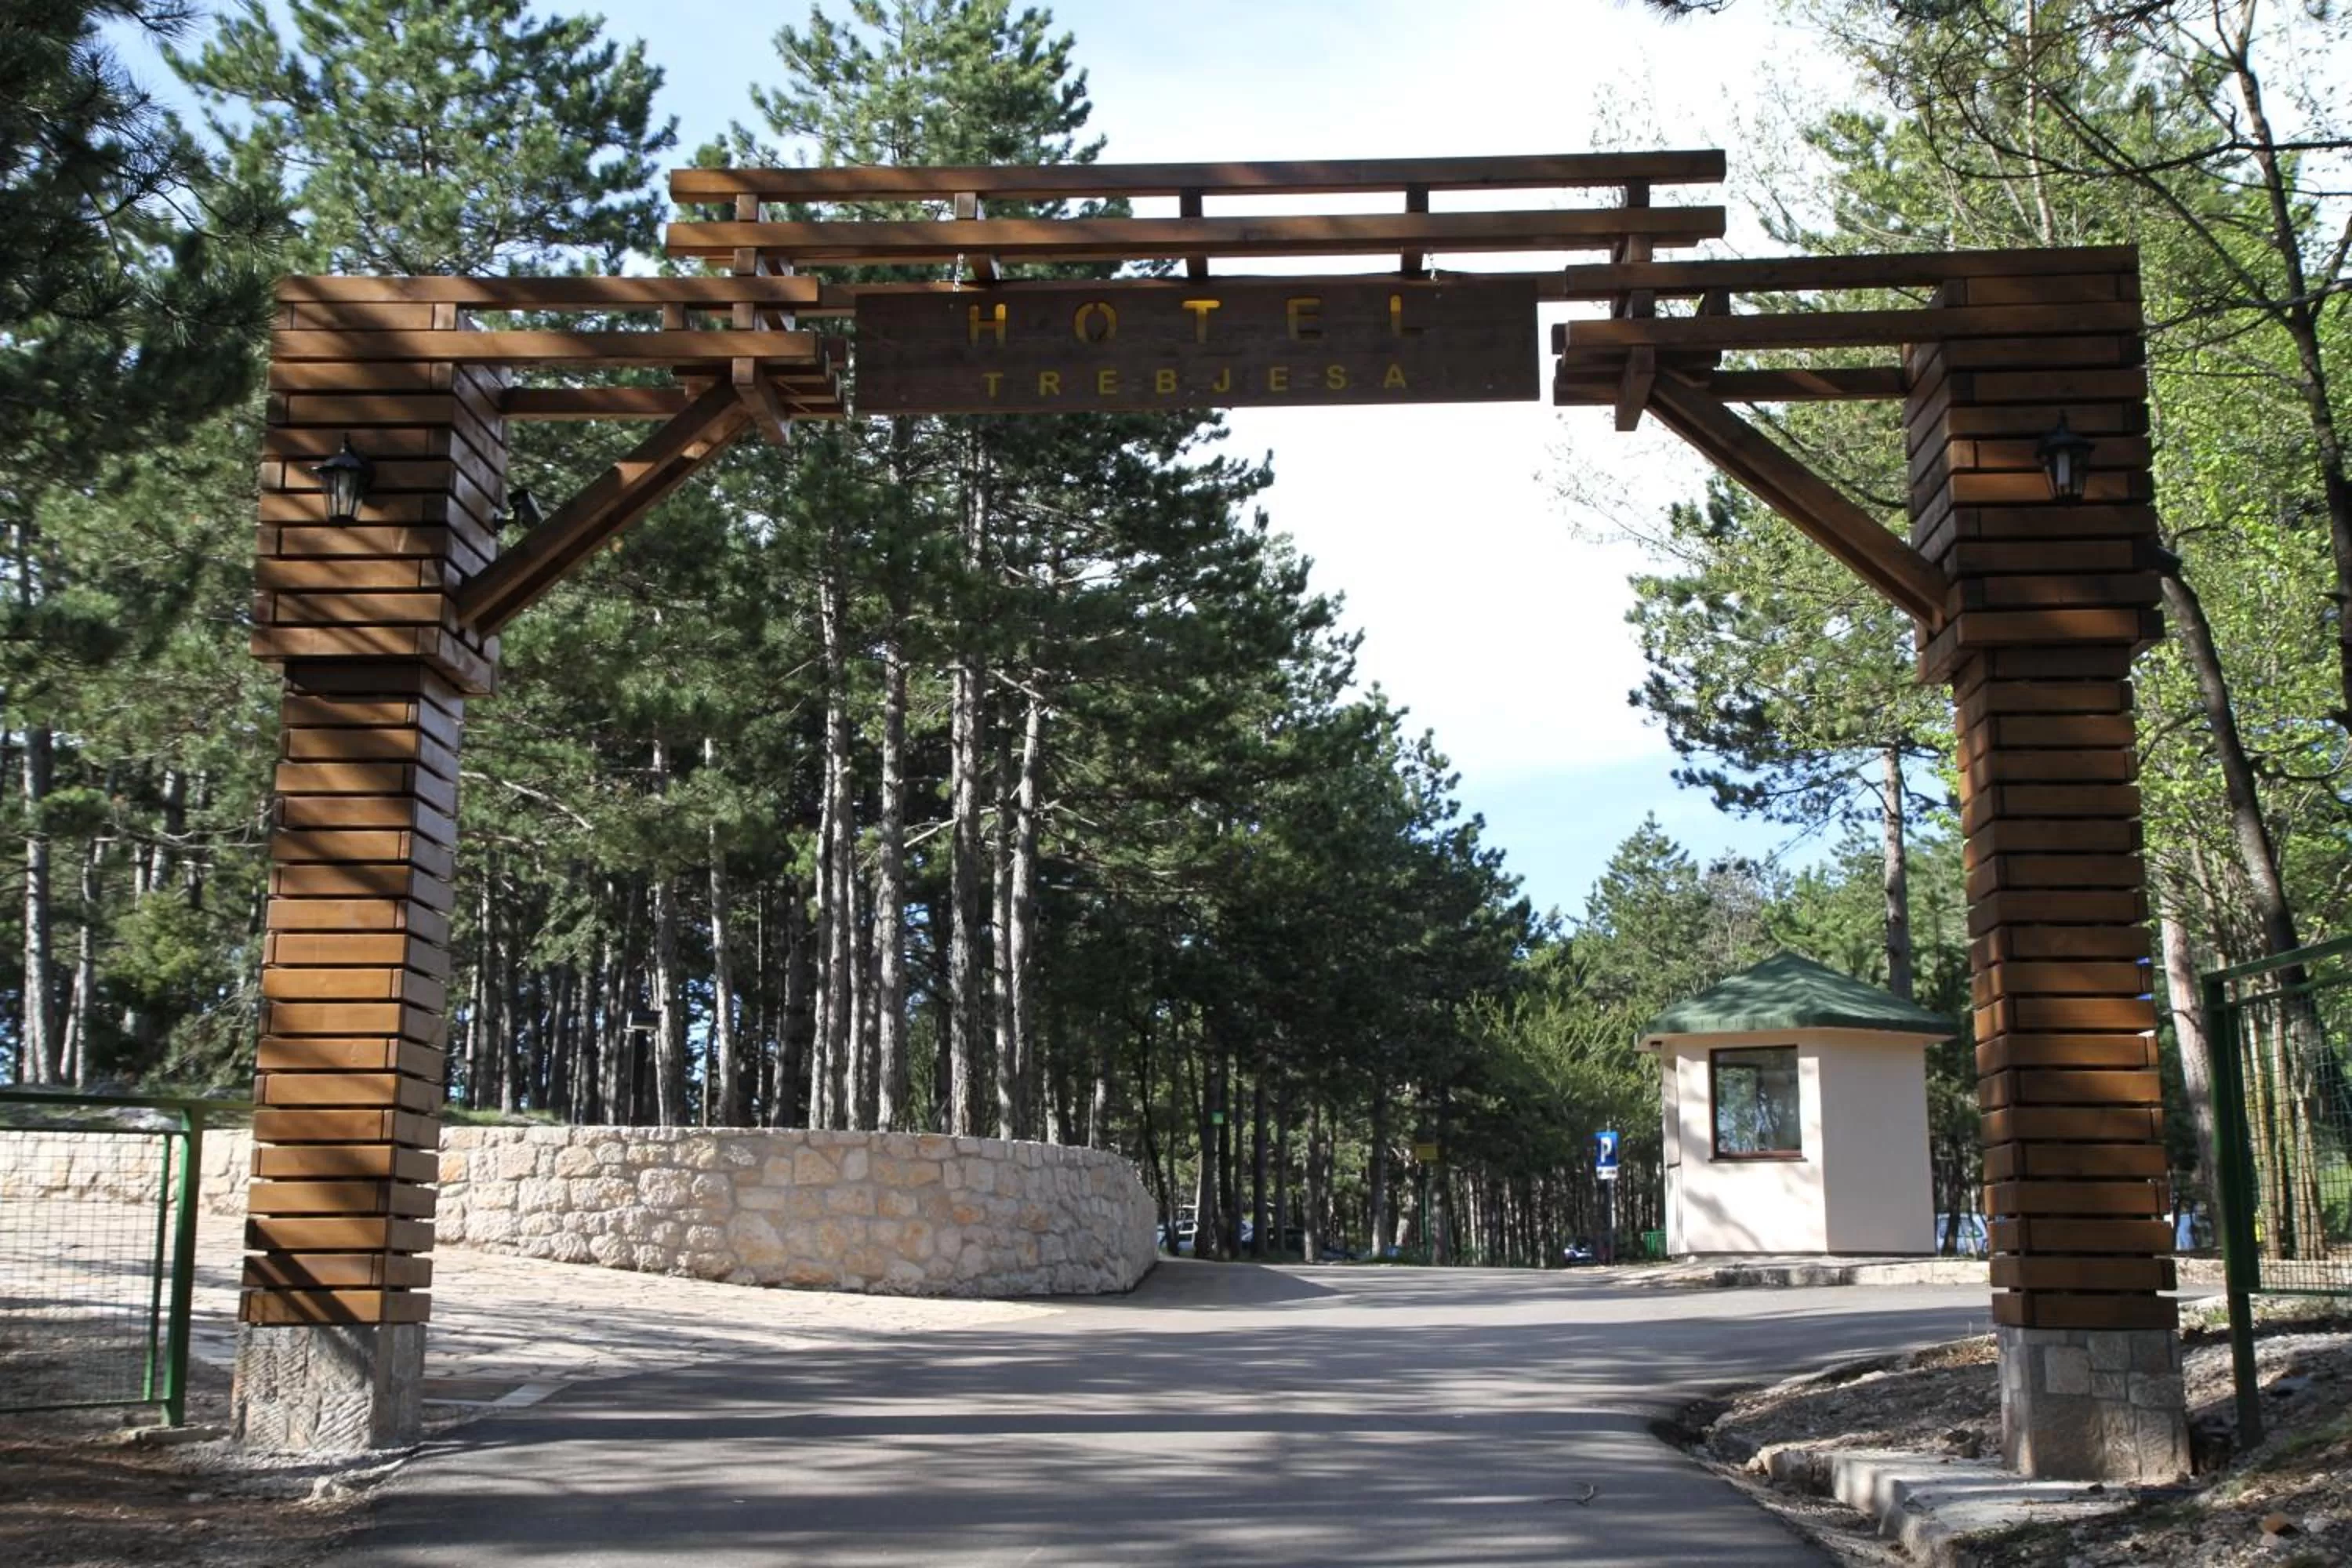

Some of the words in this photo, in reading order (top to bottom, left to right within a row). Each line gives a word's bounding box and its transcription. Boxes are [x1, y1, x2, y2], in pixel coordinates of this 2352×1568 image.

[968, 295, 1424, 347] HOTEL
[982, 364, 1407, 397] TREBJESA
[1600, 1136, 1612, 1163] P
